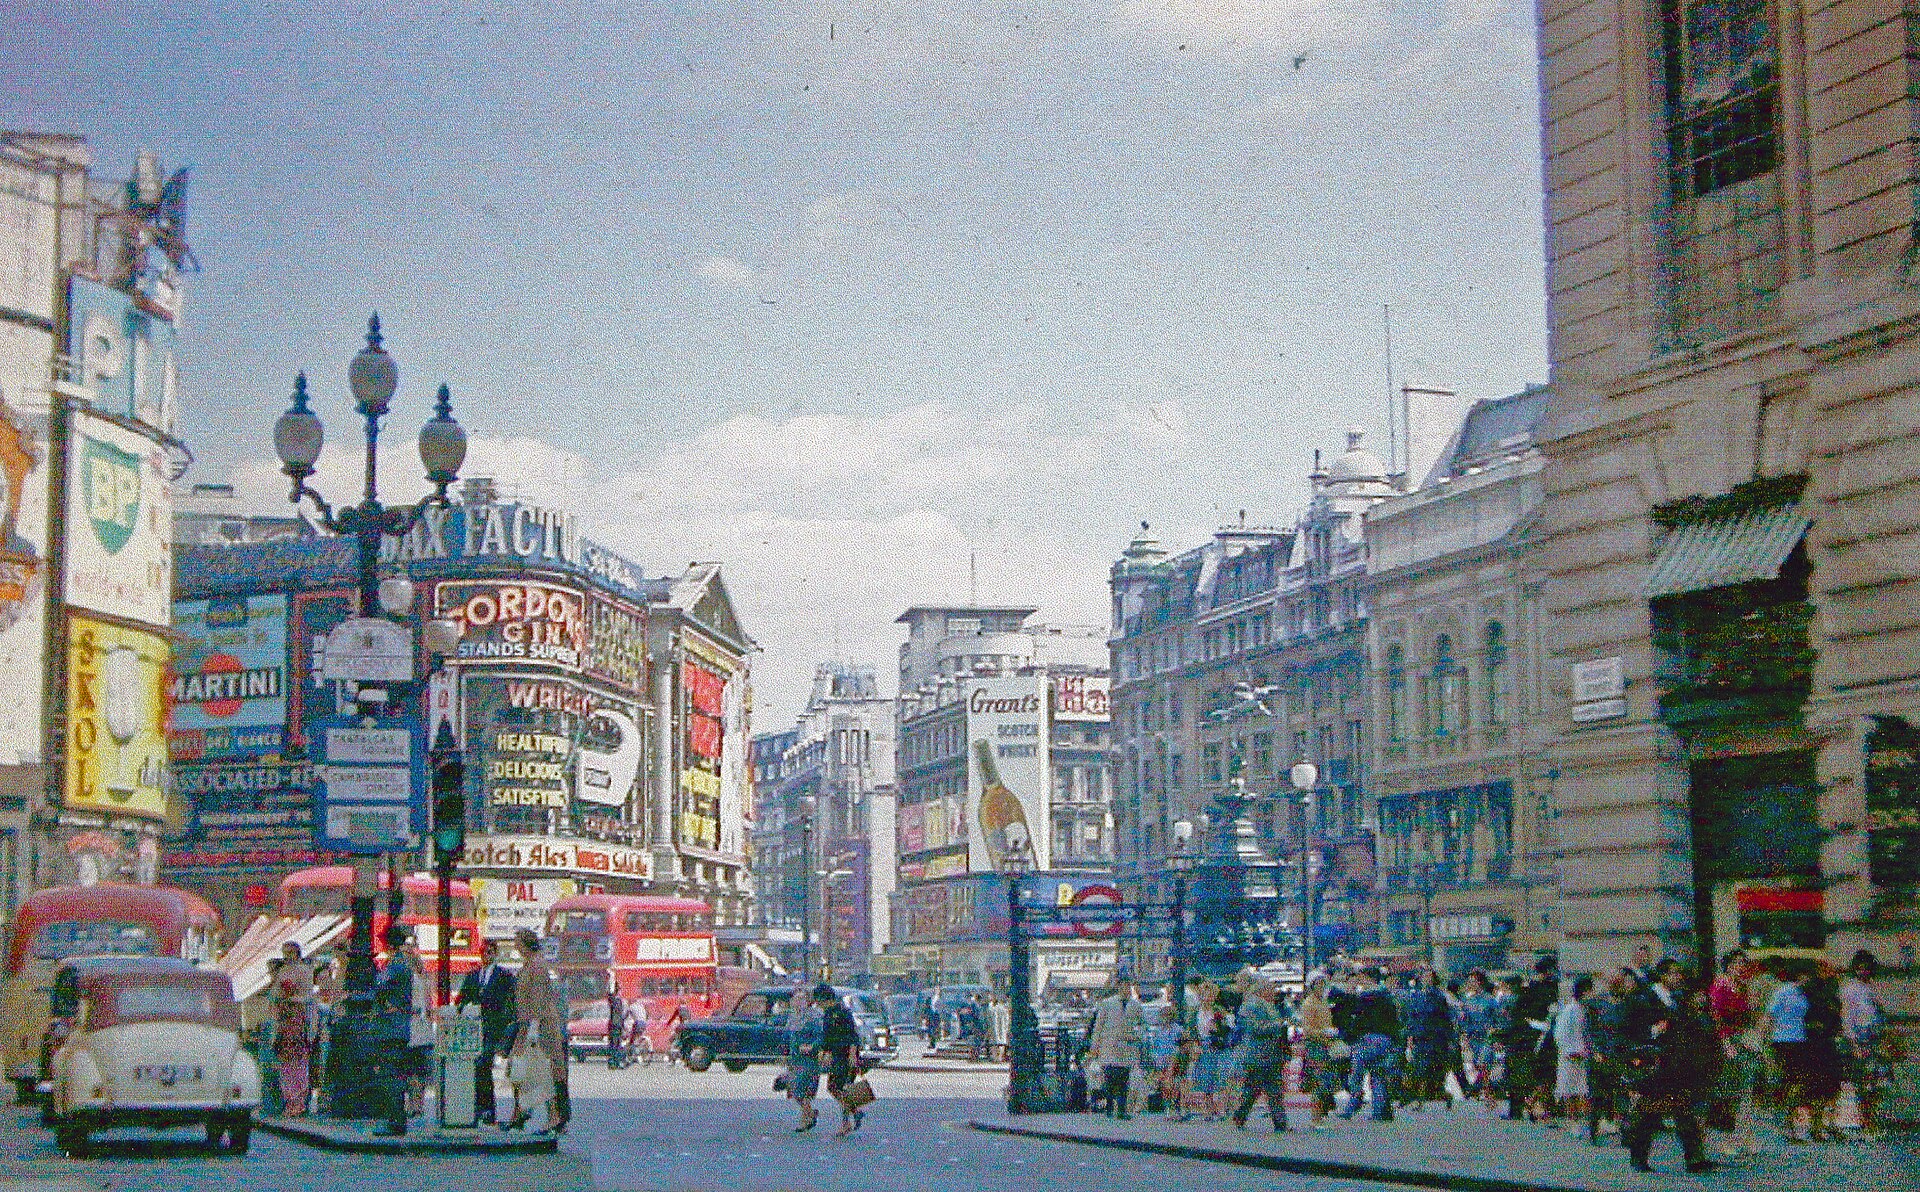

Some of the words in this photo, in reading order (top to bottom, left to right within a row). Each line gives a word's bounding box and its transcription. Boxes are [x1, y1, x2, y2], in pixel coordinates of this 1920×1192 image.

[90, 457, 138, 527] BP
[458, 642, 525, 657] STANDS
[75, 629, 98, 797] SKOL
[970, 687, 1040, 715] Grant's
[997, 723, 1040, 739] SCOTCH
[506, 882, 539, 903] PAL
